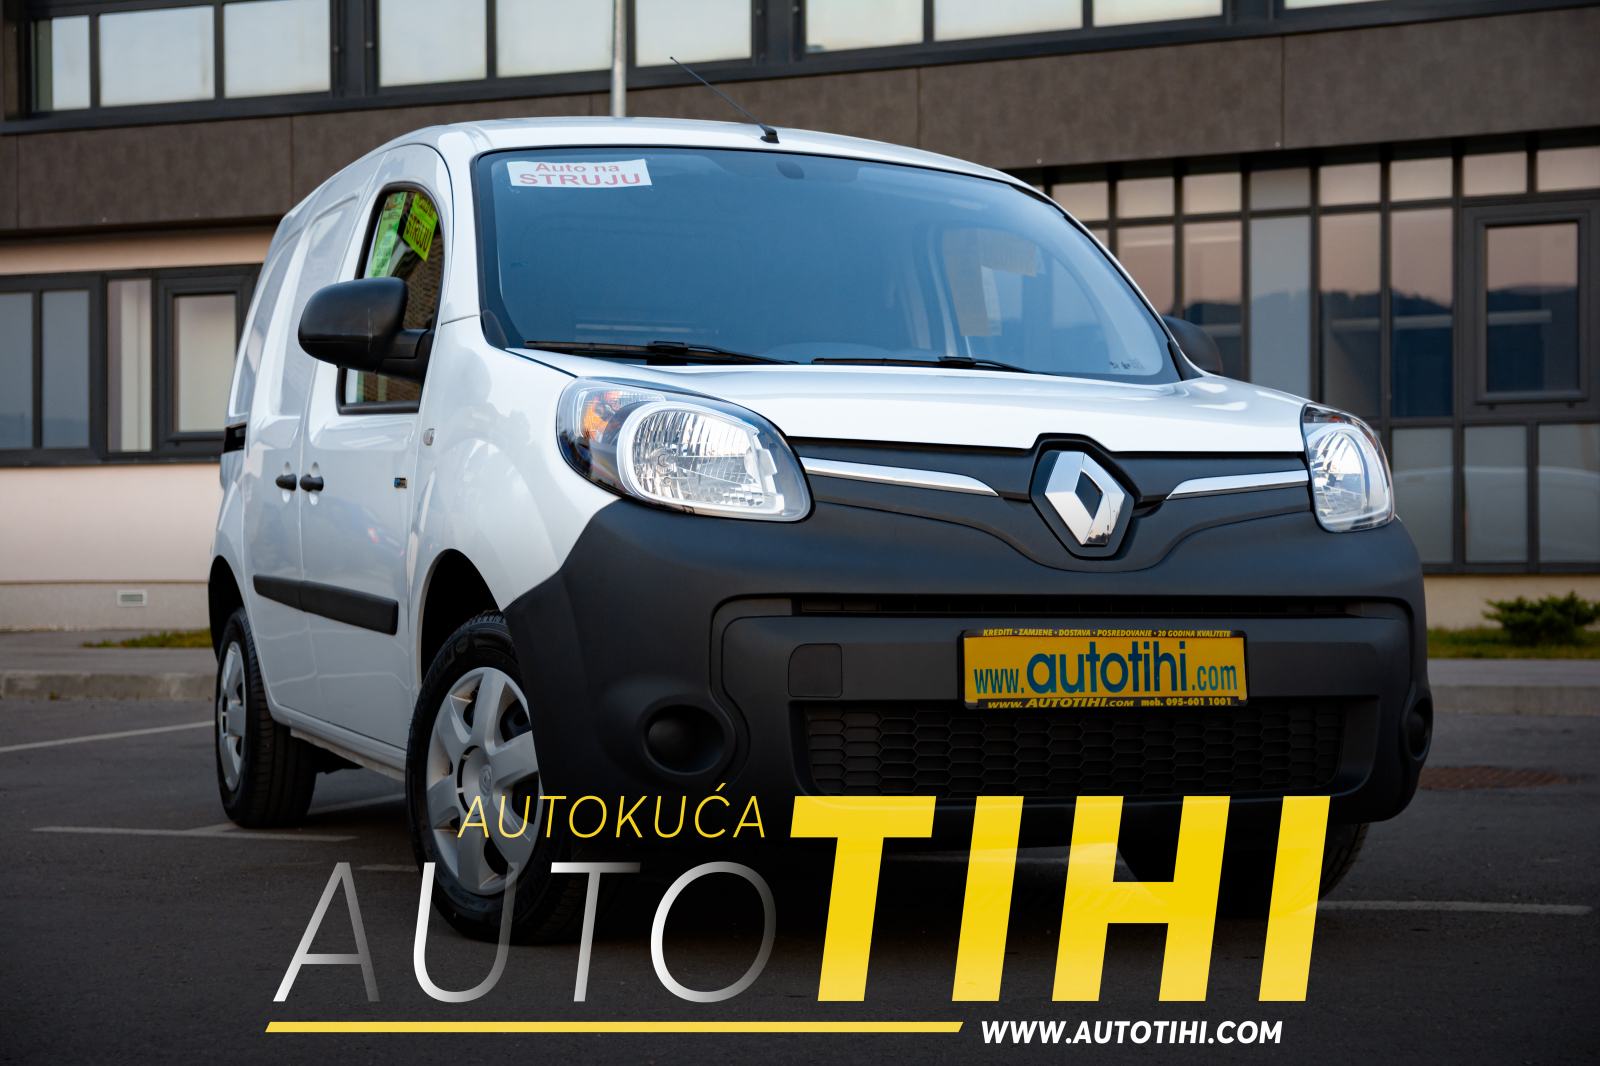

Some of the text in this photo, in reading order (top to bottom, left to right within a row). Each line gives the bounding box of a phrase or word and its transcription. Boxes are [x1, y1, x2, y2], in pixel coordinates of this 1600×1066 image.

[535, 163, 620, 173] Auto na
[519, 173, 641, 186] STRUJU
[983, 629, 1013, 637] KREDITI
[1058, 629, 1091, 637] DOSTAVA
[1097, 629, 1152, 637] POSREDOVANJE
[1166, 697, 1204, 706] 095-601
[1209, 697, 1232, 706] 1001
